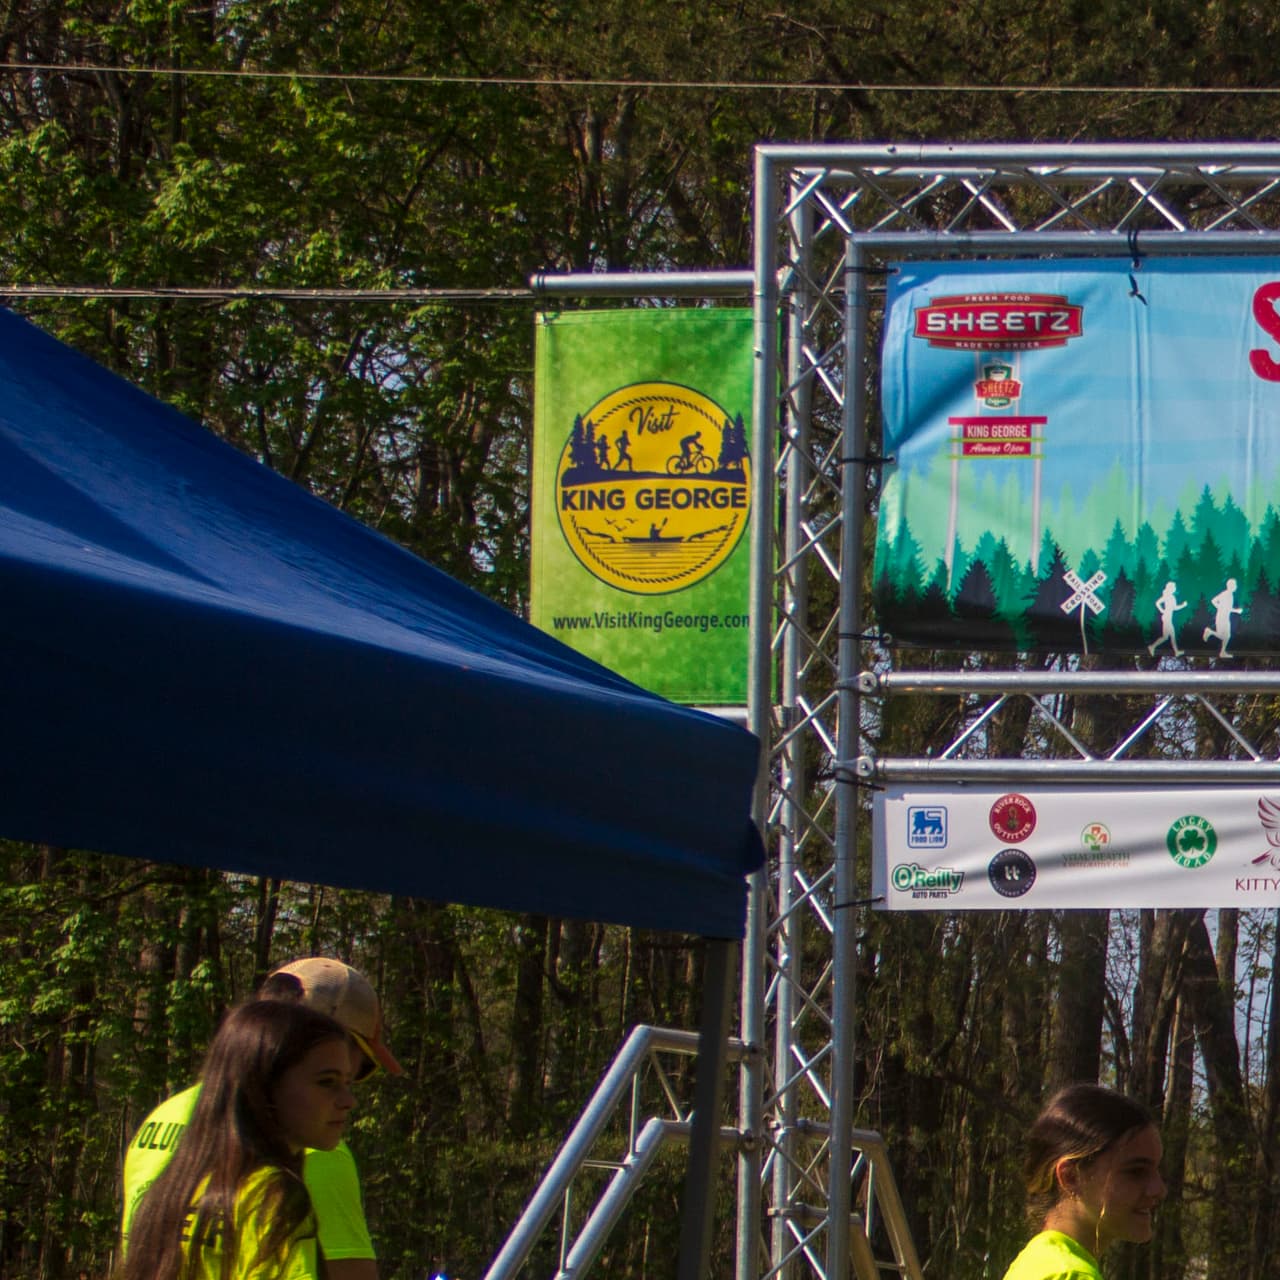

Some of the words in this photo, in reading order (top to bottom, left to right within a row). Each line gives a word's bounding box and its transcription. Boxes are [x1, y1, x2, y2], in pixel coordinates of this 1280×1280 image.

[926, 311, 1071, 332] SHEETZ
[628, 404, 681, 436] Visit
[967, 425, 989, 438] KING
[991, 425, 1027, 438] GEORGE
[561, 489, 626, 512] KING
[635, 487, 747, 510] GEORGE
[1171, 815, 1215, 833] LUCKY
[1174, 853, 1213, 867] ROAD
[894, 864, 962, 891] O'Reilly
[1235, 877, 1280, 892] KITTY
